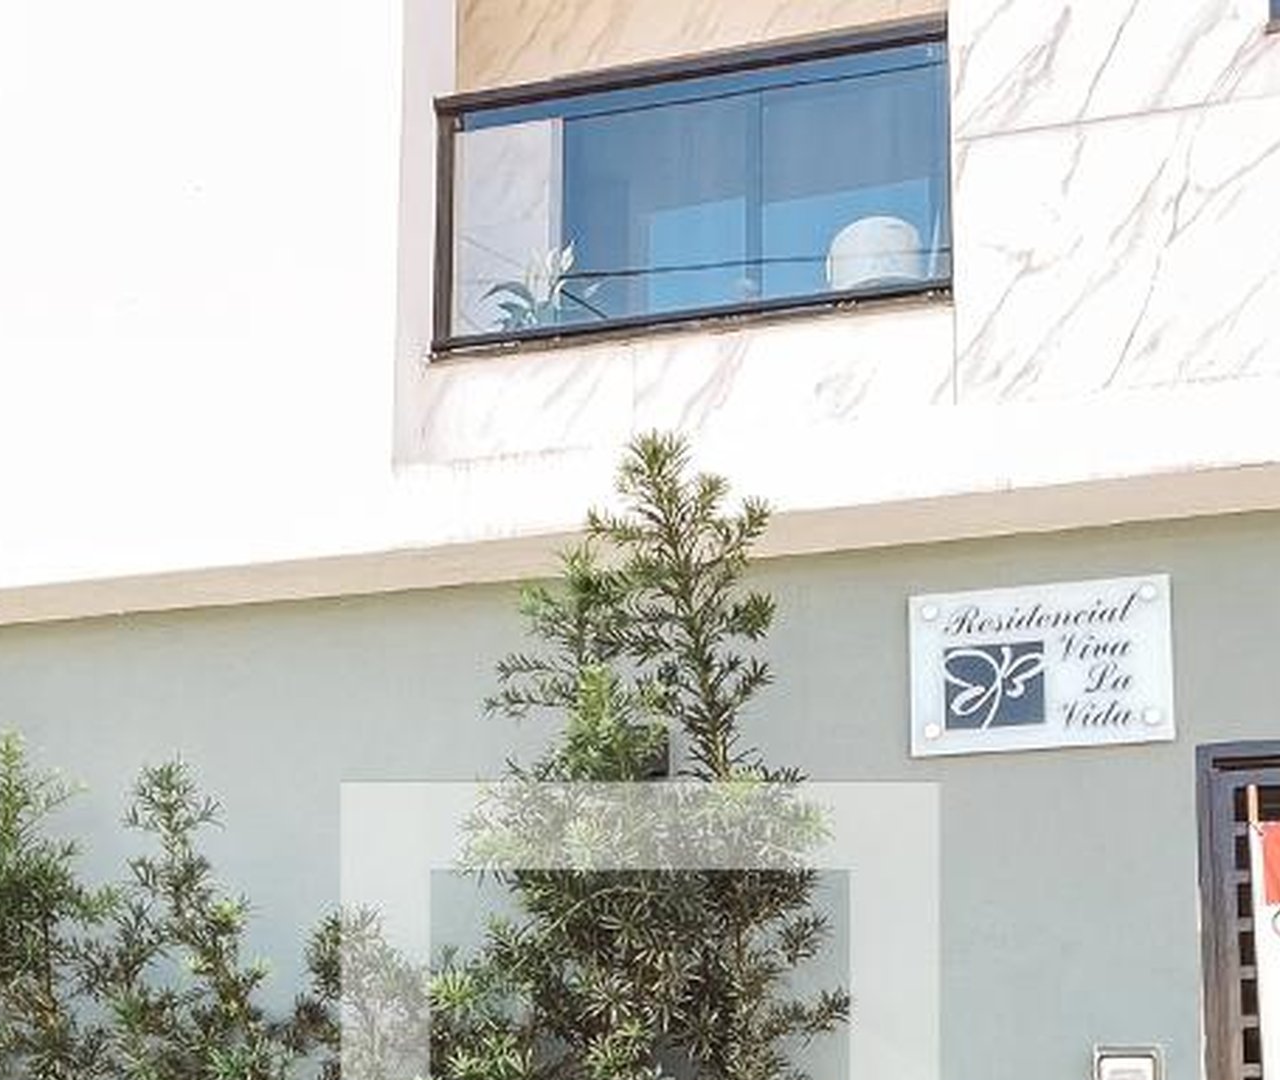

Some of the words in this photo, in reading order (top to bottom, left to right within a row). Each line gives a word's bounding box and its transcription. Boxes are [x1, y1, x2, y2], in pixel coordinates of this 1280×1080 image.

[944, 595, 1139, 634] Residencial
[1062, 634, 1132, 660] Viva
[1085, 663, 1132, 693] La
[1062, 700, 1136, 727] Vida
